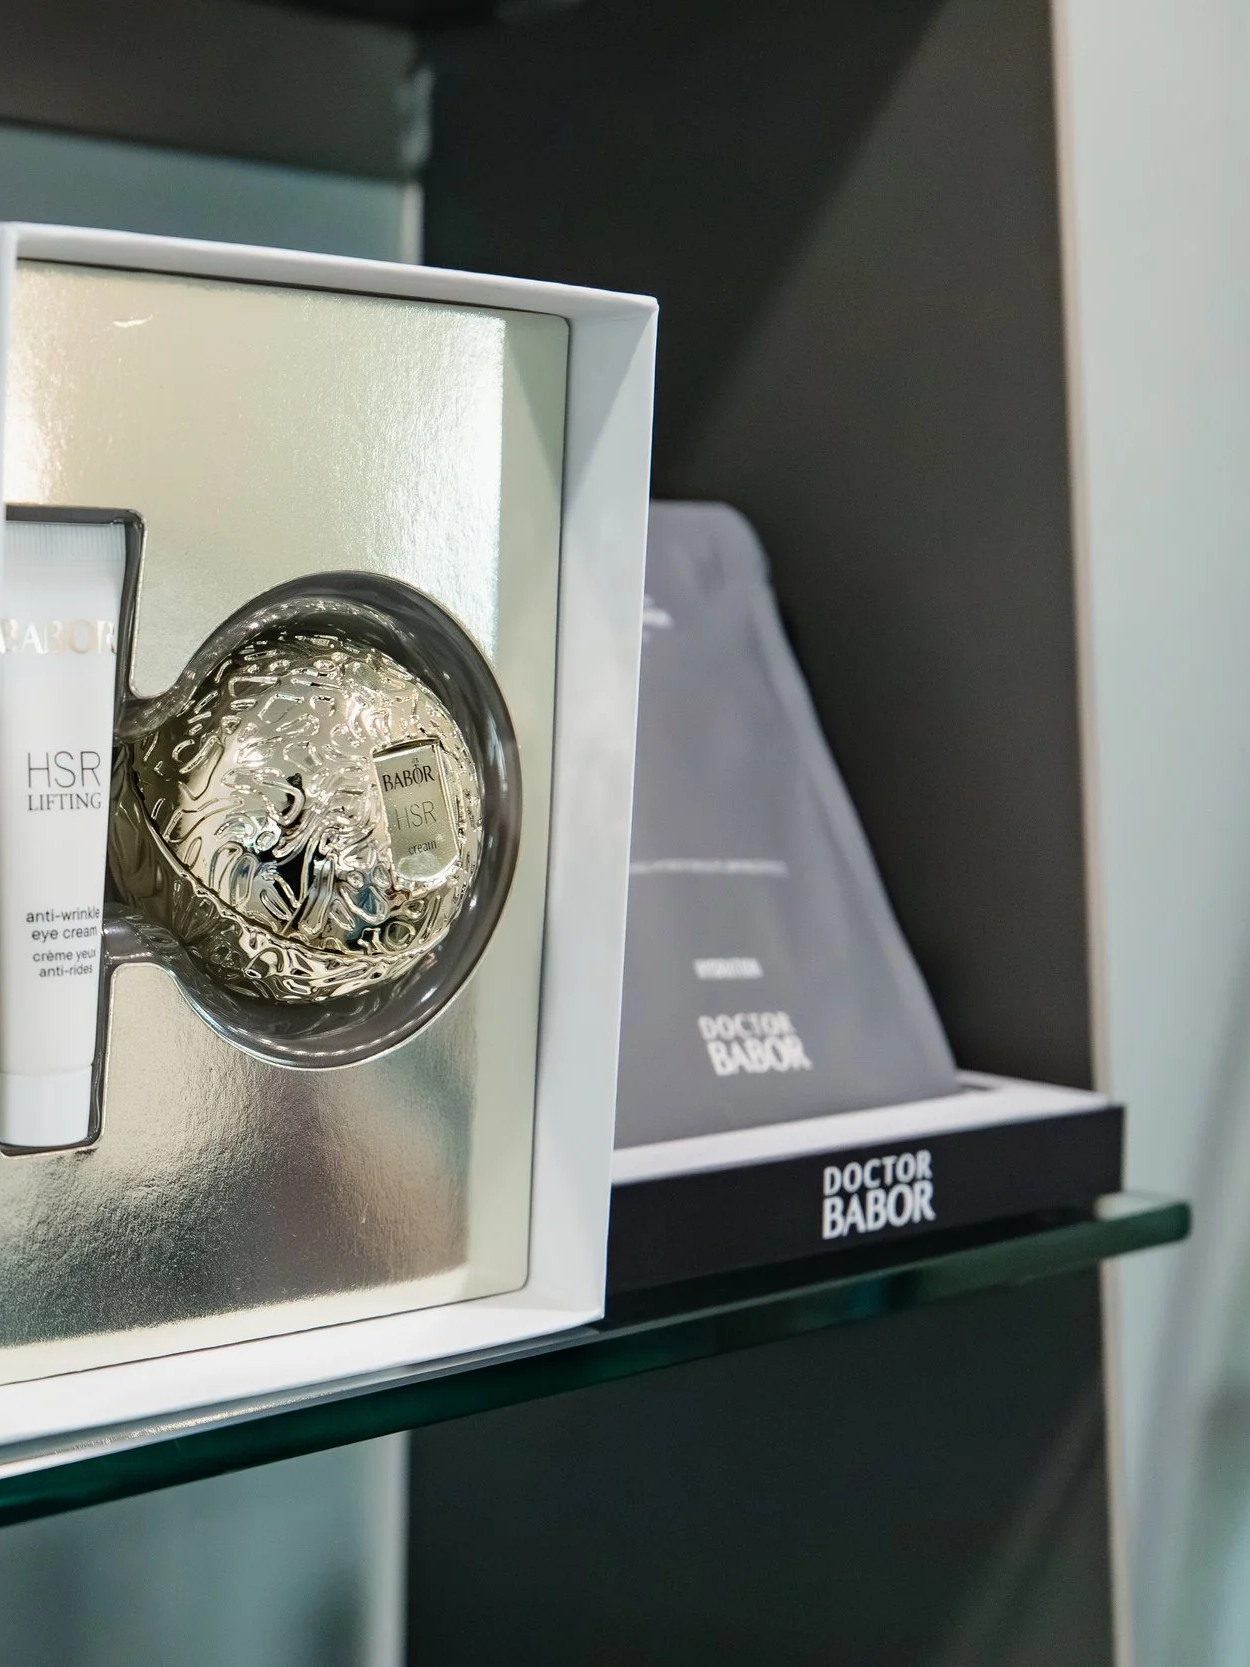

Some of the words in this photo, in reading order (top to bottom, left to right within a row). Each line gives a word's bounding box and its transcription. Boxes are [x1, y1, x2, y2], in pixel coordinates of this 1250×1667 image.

[28, 751, 101, 788] HSR
[382, 765, 435, 792] BABOR
[27, 793, 101, 811] LIFTING
[395, 801, 437, 831] HSR
[408, 840, 437, 856] cream
[26, 906, 100, 923] anti-wrinkle
[32, 929, 58, 943] eye
[63, 926, 97, 939] cream
[32, 950, 72, 963] crème
[39, 964, 93, 978] anti-rides
[697, 1011, 796, 1041] DOCTOR
[707, 1034, 813, 1076] BABOR
[823, 1149, 933, 1196] DOCTOR
[822, 1180, 936, 1240] BABOR
